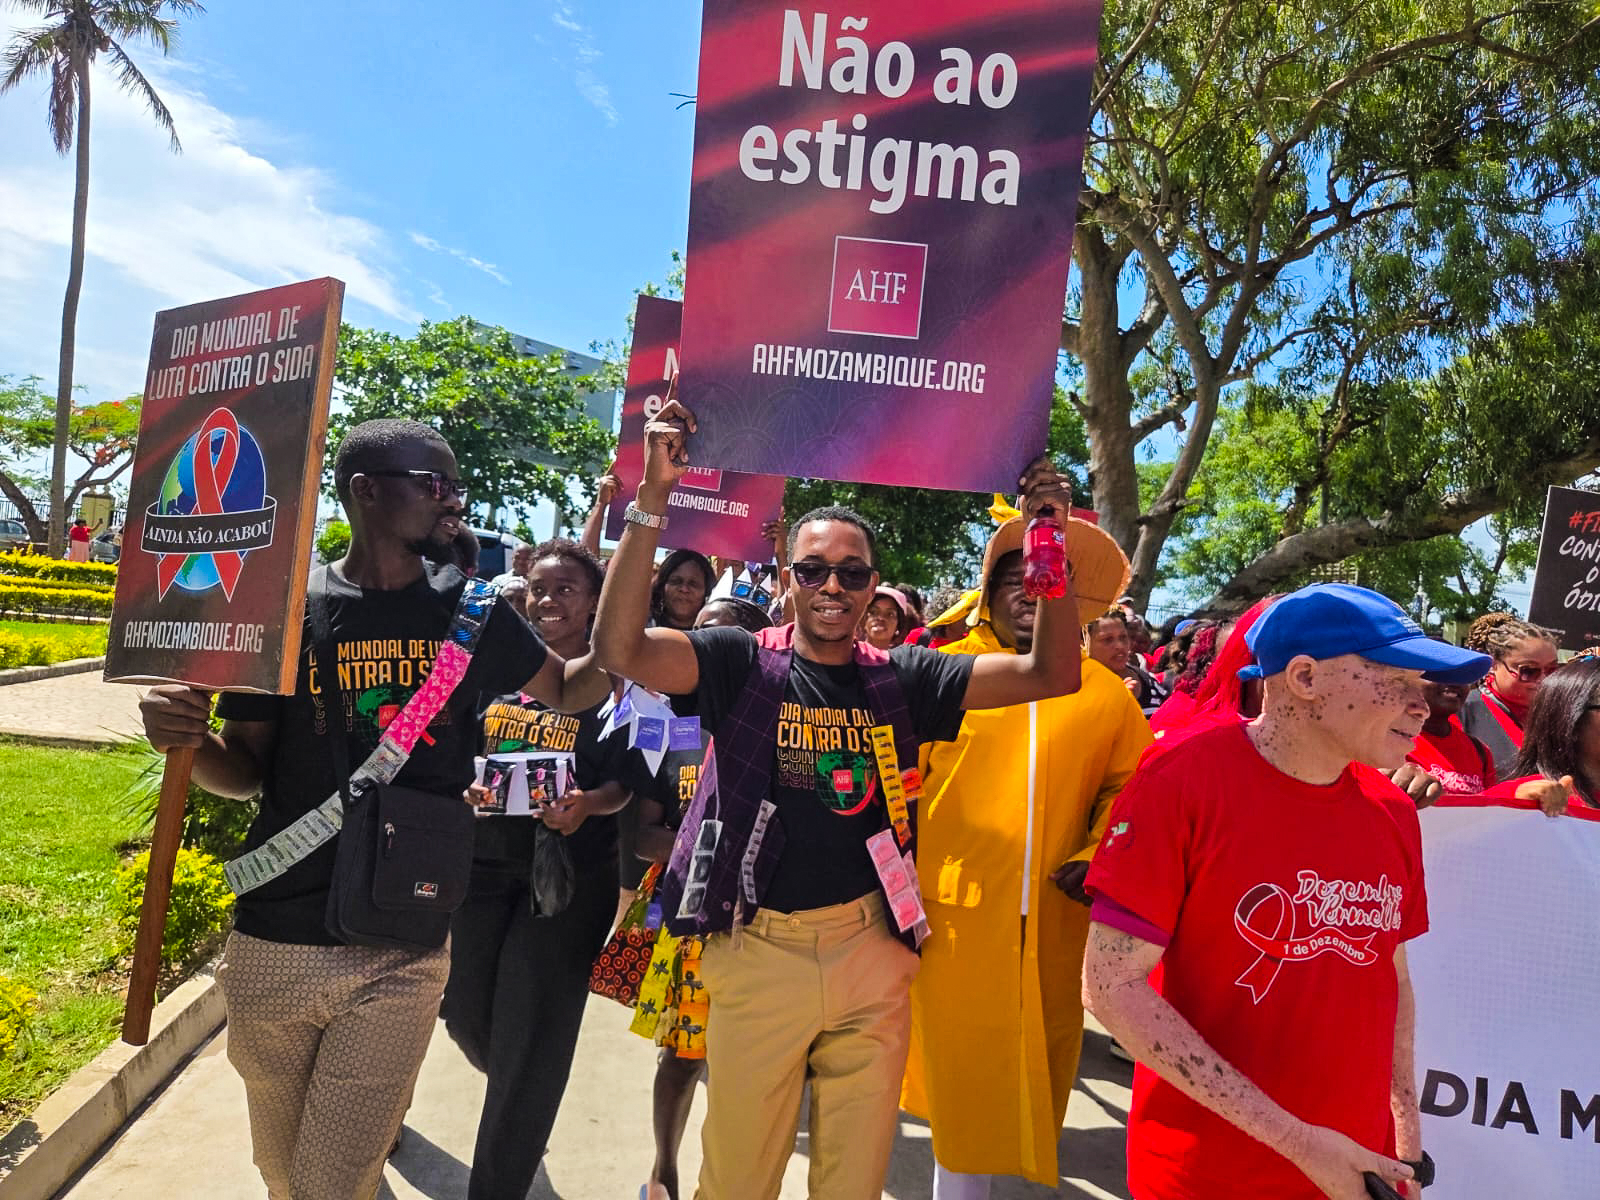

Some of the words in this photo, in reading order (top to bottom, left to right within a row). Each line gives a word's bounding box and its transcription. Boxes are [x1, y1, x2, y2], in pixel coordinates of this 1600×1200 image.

[778, 9, 914, 98] Não
[933, 47, 1018, 109] ao
[738, 114, 1021, 214] estigma
[844, 270, 906, 305] AHF
[170, 325, 198, 360] DIA
[200, 311, 271, 354] MUNDIAL
[277, 306, 300, 342] DE
[150, 366, 186, 400] LUTA
[188, 355, 252, 395] CONTRA
[255, 352, 269, 386] O
[273, 345, 314, 383] SIDA
[752, 343, 985, 394] AHFMOZAMBIQUE.ORG
[145, 525, 183, 544] AINDA
[186, 527, 213, 544] NÃO
[215, 519, 272, 543] ACABOU
[123, 620, 265, 654] AHFMOZAMBIQUE.ORG
[337, 640, 405, 661] MUNDIAL
[409, 640, 426, 659] DE
[399, 660, 412, 687] O
[779, 702, 802, 722] DIA
[528, 725, 541, 745] O
[541, 726, 578, 752] SIDA
[1283, 944, 1289, 955] 1
[1293, 944, 1309, 955] de
[1309, 935, 1366, 961] Dezembro
[1419, 1069, 1540, 1135] DIA
